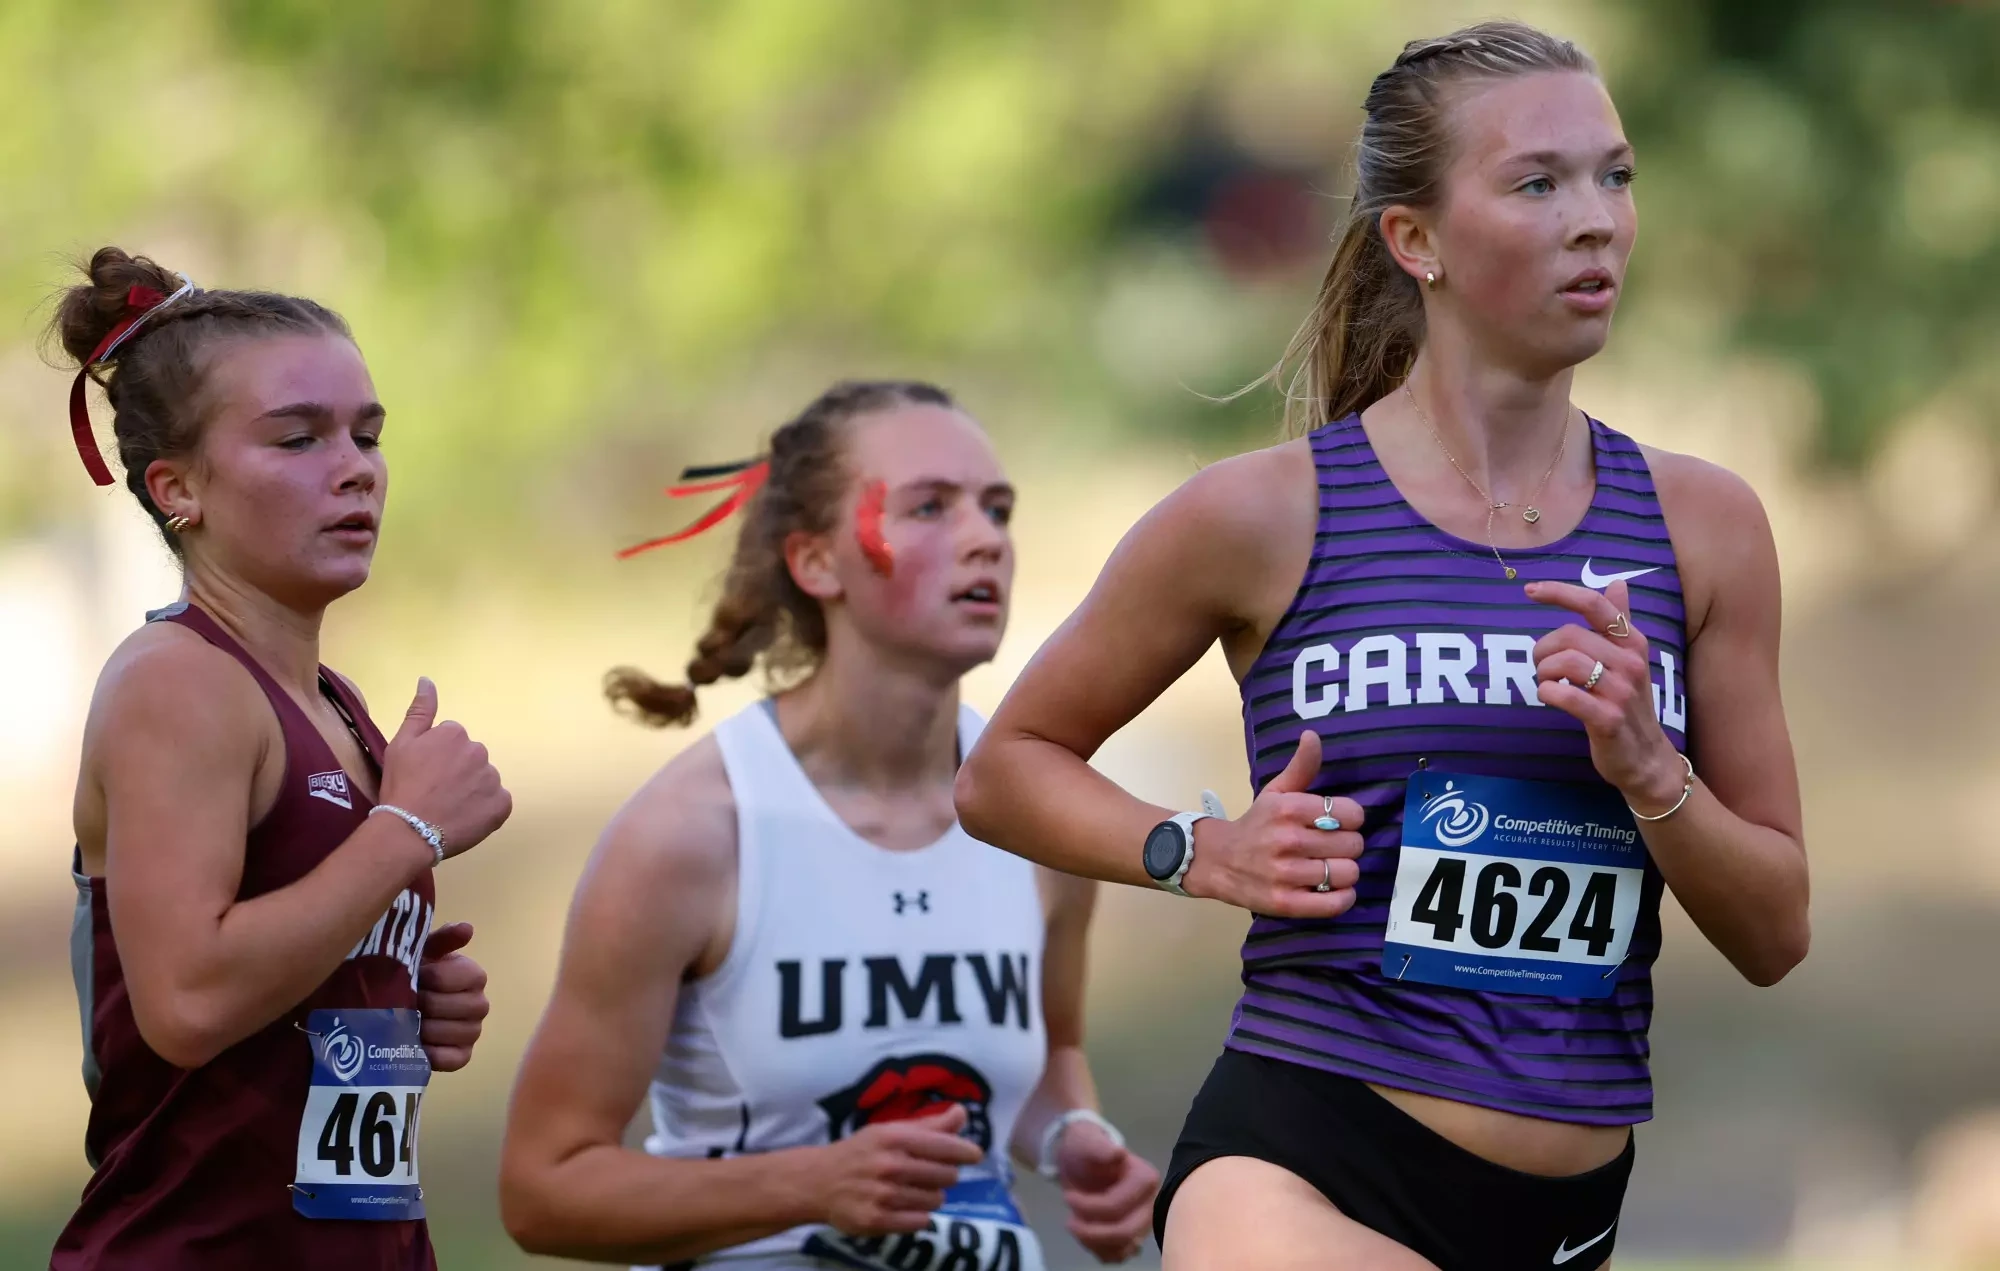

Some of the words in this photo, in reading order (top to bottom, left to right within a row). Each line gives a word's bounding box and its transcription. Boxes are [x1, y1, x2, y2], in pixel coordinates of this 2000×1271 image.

[1292, 632, 1686, 734] CARRL
[1494, 834, 1537, 845] ACCURATE
[1540, 838, 1576, 848] RESULTS
[1582, 843, 1609, 852] EVERY
[1611, 844, 1633, 853] TIME
[1410, 857, 1618, 957] 4624
[775, 953, 1030, 1040] UMW
[1454, 964, 1563, 982] www.CompetitiveTiming.com
[317, 1091, 422, 1178] 464
